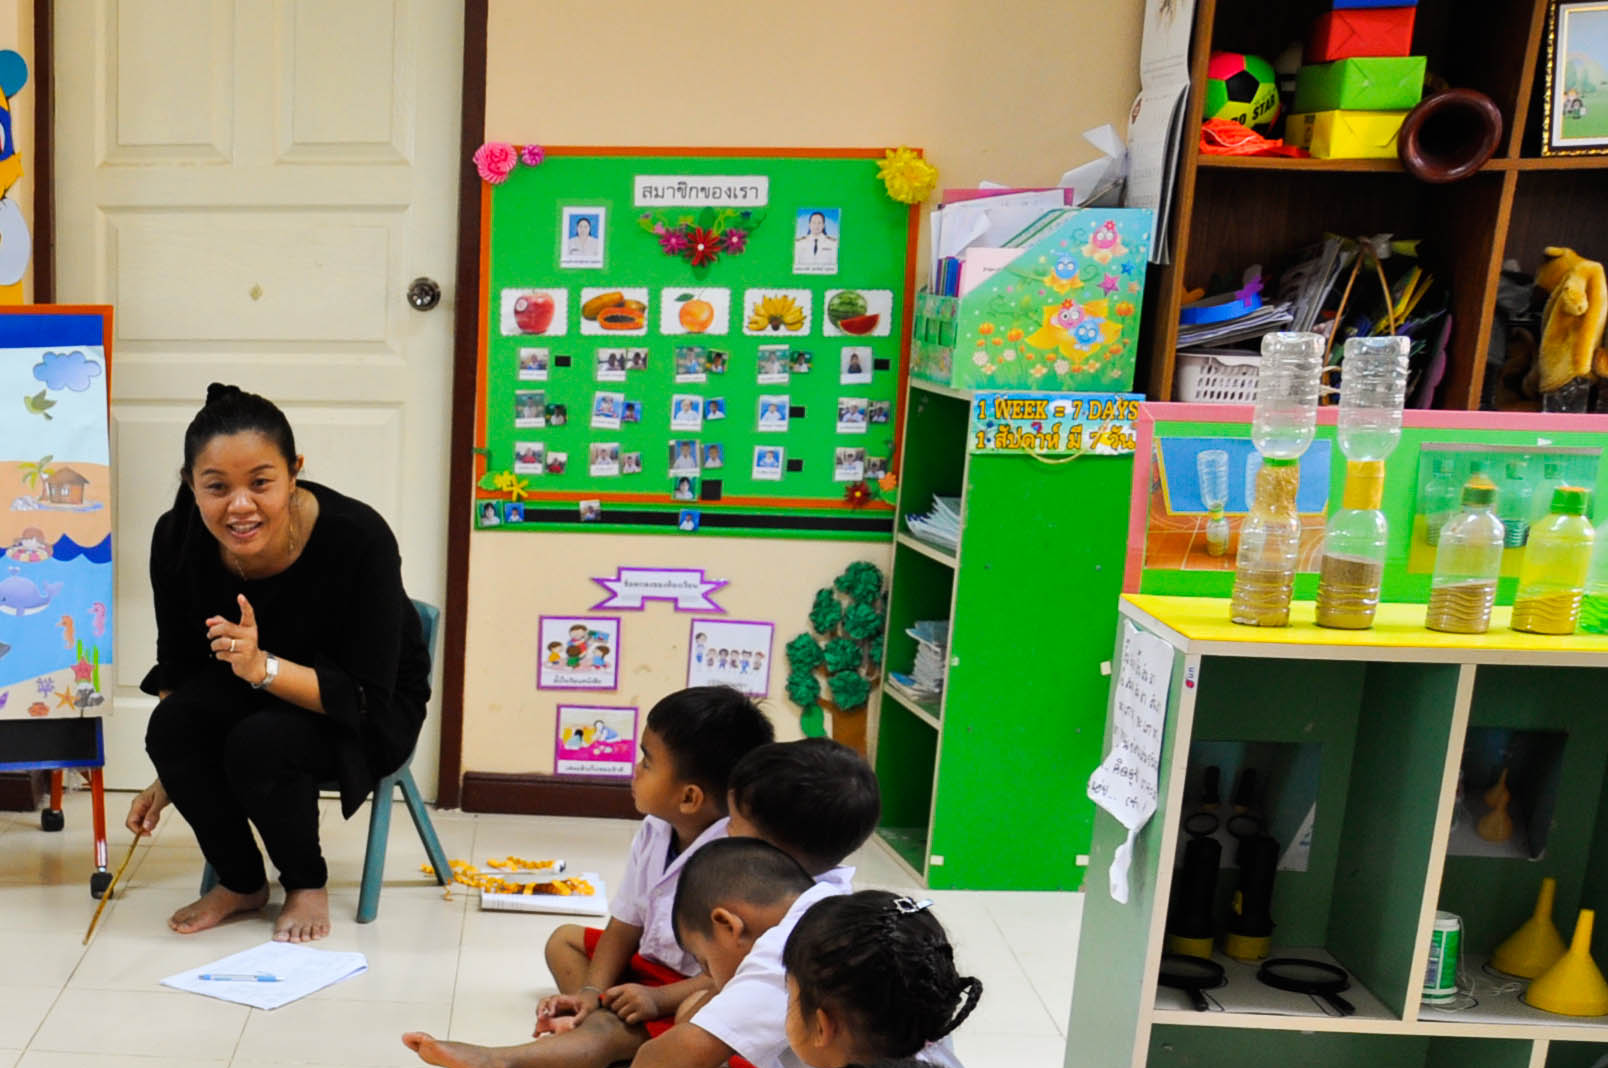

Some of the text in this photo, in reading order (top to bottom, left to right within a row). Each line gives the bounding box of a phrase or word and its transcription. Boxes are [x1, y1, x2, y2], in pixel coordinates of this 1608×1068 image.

[1252, 95, 1275, 120] STAR
[642, 181, 759, 200] สมาชิกของเรา
[978, 399, 987, 420] 1
[995, 398, 1048, 420] WEEK
[1072, 400, 1083, 420] 7
[1088, 399, 1139, 420] DAYS
[976, 430, 985, 449] 1
[995, 423, 1062, 449] สัปดาห์
[1067, 424, 1083, 449] มี
[1107, 425, 1137, 449] วัน
